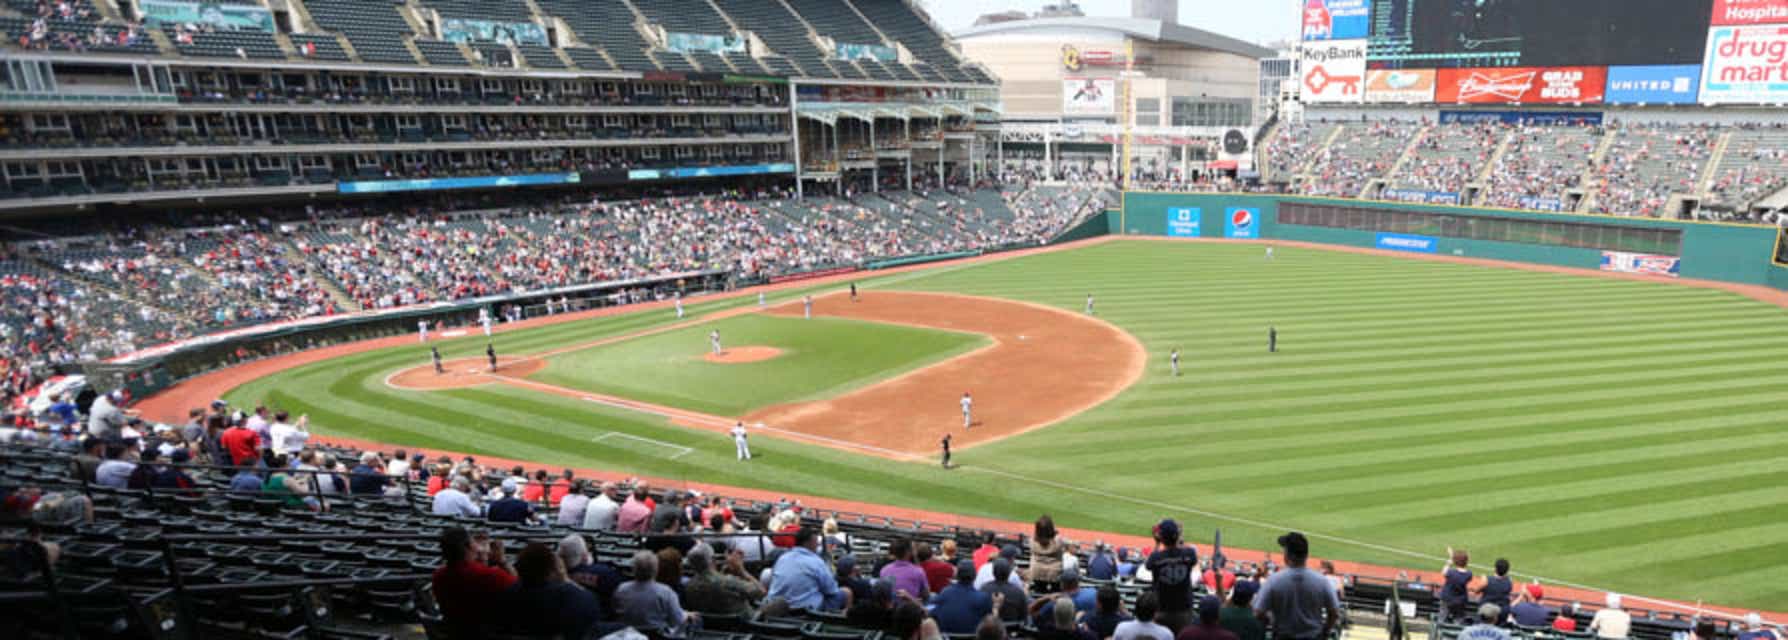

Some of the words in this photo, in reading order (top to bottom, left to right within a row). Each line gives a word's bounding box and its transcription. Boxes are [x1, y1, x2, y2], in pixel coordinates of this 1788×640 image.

[1303, 46, 1363, 61] KeyBank
[1719, 28, 1787, 64] drug
[1720, 62, 1788, 82] mart
[1611, 80, 1672, 91] UNITED
